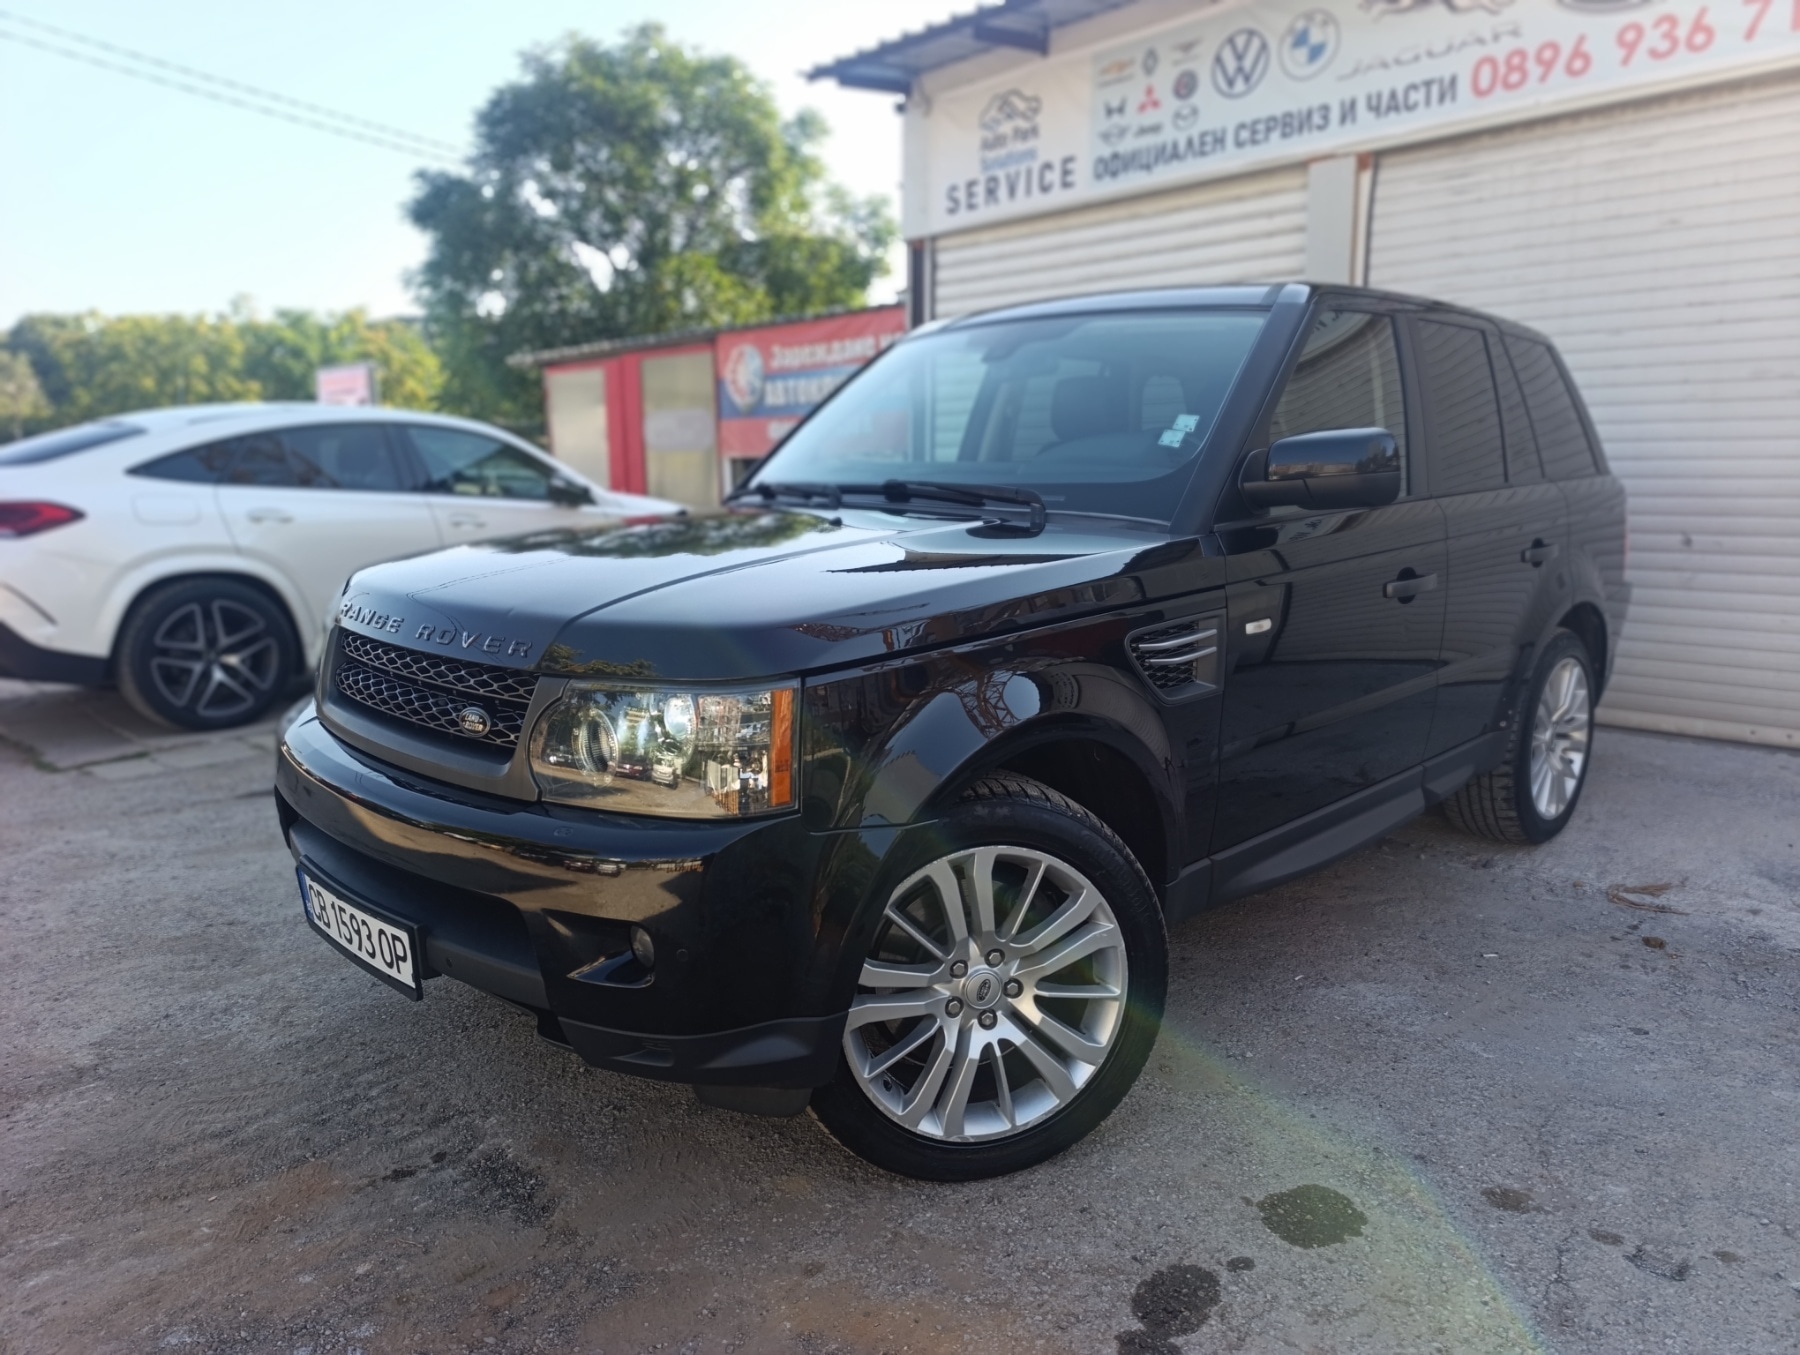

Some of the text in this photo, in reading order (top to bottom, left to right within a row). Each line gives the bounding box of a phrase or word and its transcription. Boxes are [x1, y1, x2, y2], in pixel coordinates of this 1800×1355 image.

[1093, 125, 1227, 181] ОФИЦИАЛЕН
[1233, 102, 1331, 150] СЕРВИЗ
[1338, 97, 1358, 128] И
[1365, 73, 1458, 120] ЧАСТИ
[1470, 34, 1593, 99] 0896
[1615, 5, 1716, 67] 936
[946, 155, 1077, 215] SERVICE
[340, 602, 534, 658] RANGE ROVER
[331, 901, 376, 960] 1593
